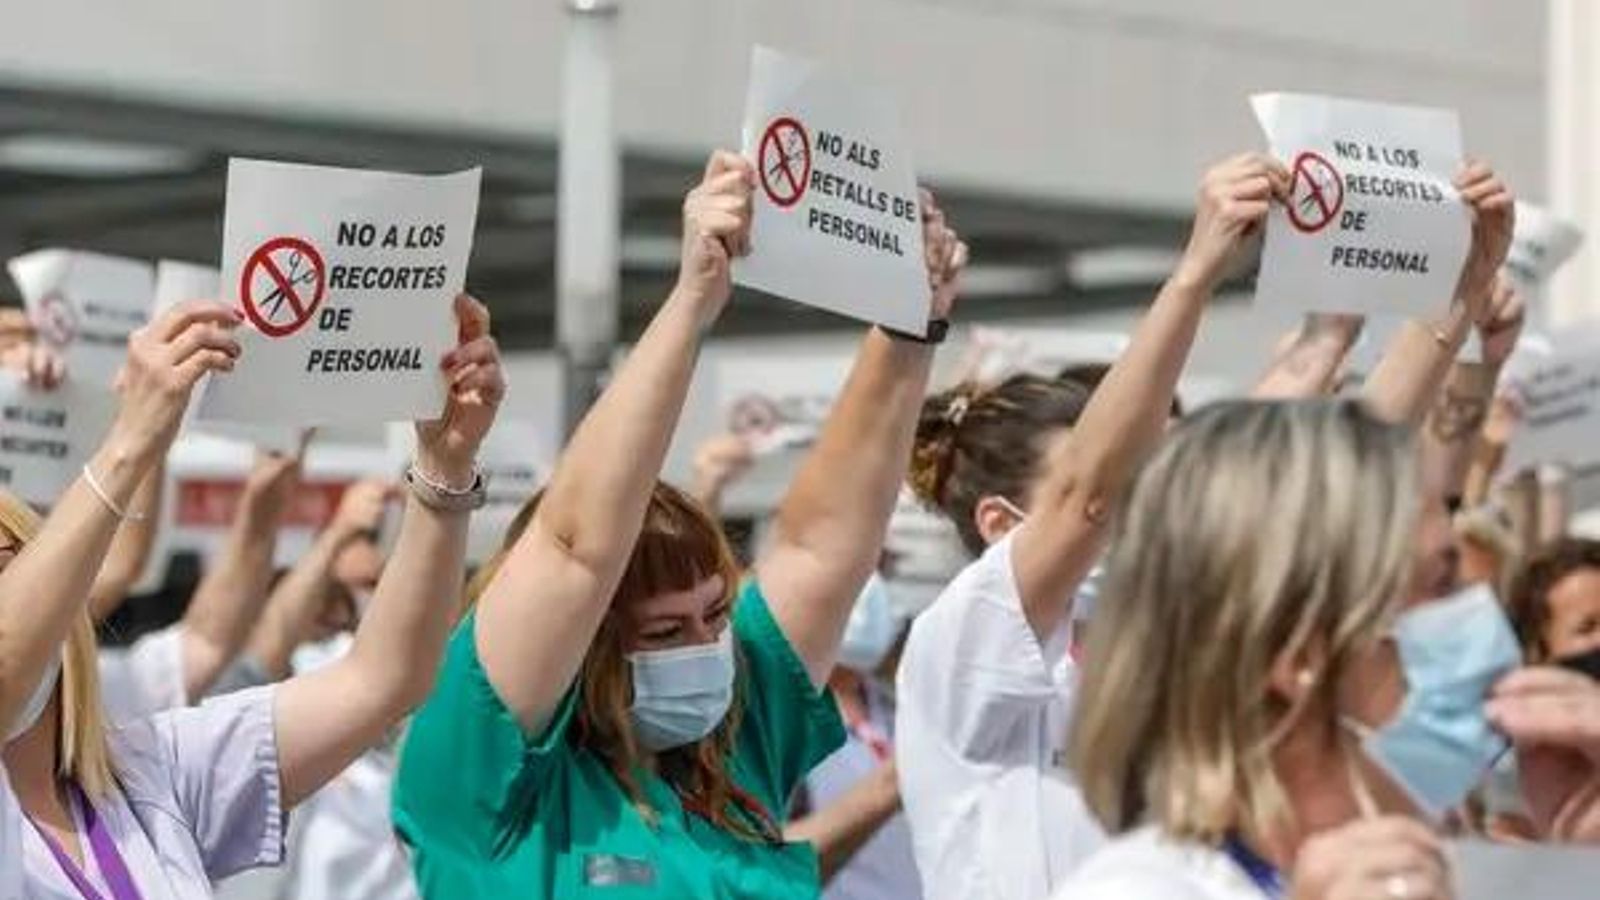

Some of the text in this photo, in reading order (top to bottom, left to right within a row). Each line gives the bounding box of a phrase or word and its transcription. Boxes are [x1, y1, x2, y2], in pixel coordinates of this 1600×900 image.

[816, 131, 880, 169] NO ALS
[1334, 141, 1361, 159] NO
[1383, 148, 1419, 168] LOS
[810, 170, 916, 222] RETALLS DE
[1345, 175, 1442, 202] RECORTES
[809, 208, 903, 256] PERSONAL
[1341, 211, 1367, 231] DE
[338, 222, 445, 248] NO A LOS
[1332, 246, 1429, 273] PERSONAL
[329, 265, 446, 289] RECORTES
[318, 308, 352, 331] DE
[307, 349, 422, 371] PERSONAL
